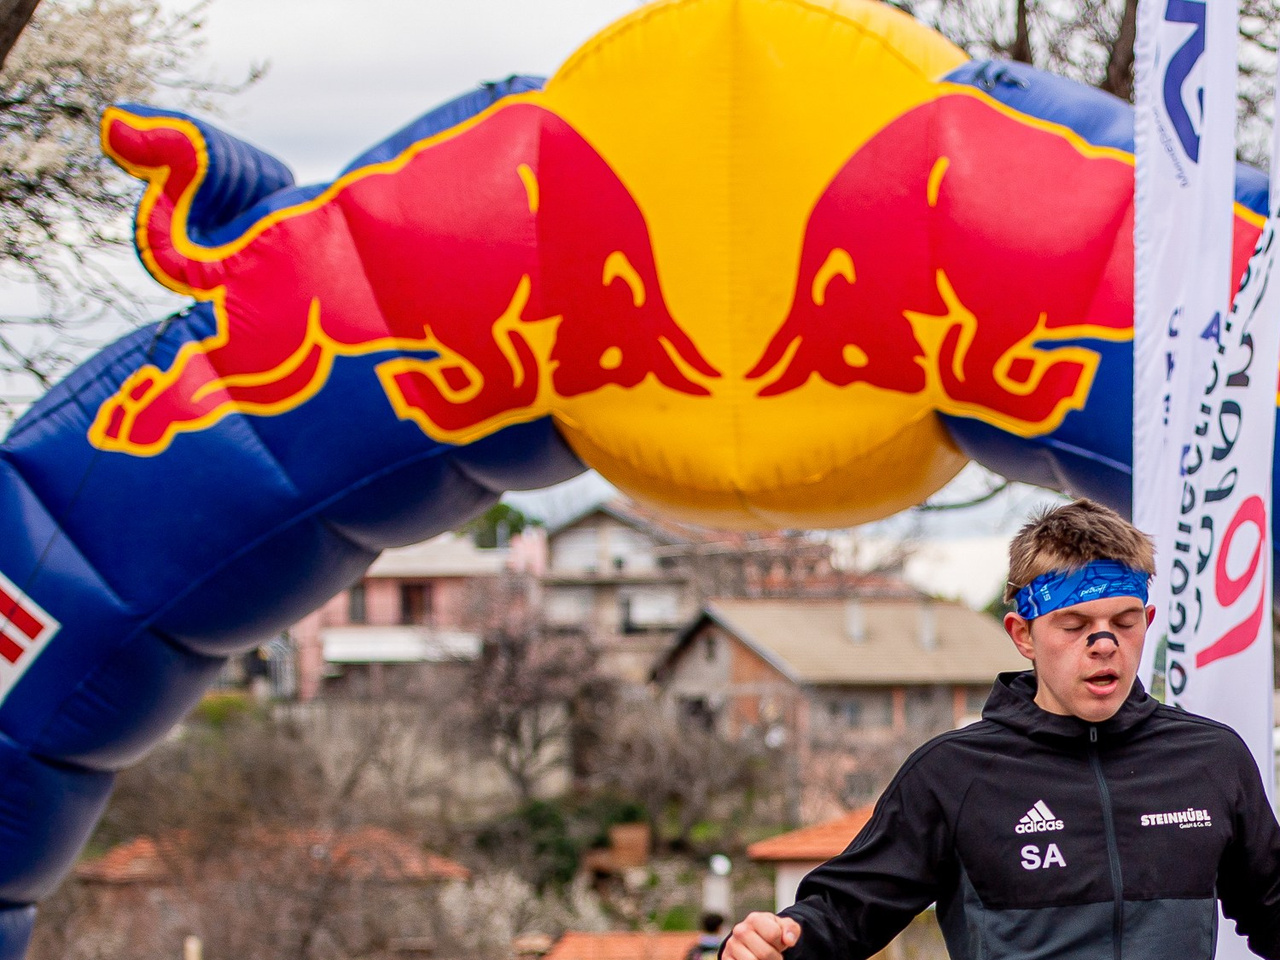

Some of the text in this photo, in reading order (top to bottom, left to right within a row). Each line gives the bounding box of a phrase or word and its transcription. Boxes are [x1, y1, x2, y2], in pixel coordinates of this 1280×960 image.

[1140, 808, 1211, 826] STEINHÜBL
[1015, 819, 1064, 834] adidas
[1021, 843, 1067, 870] SA
